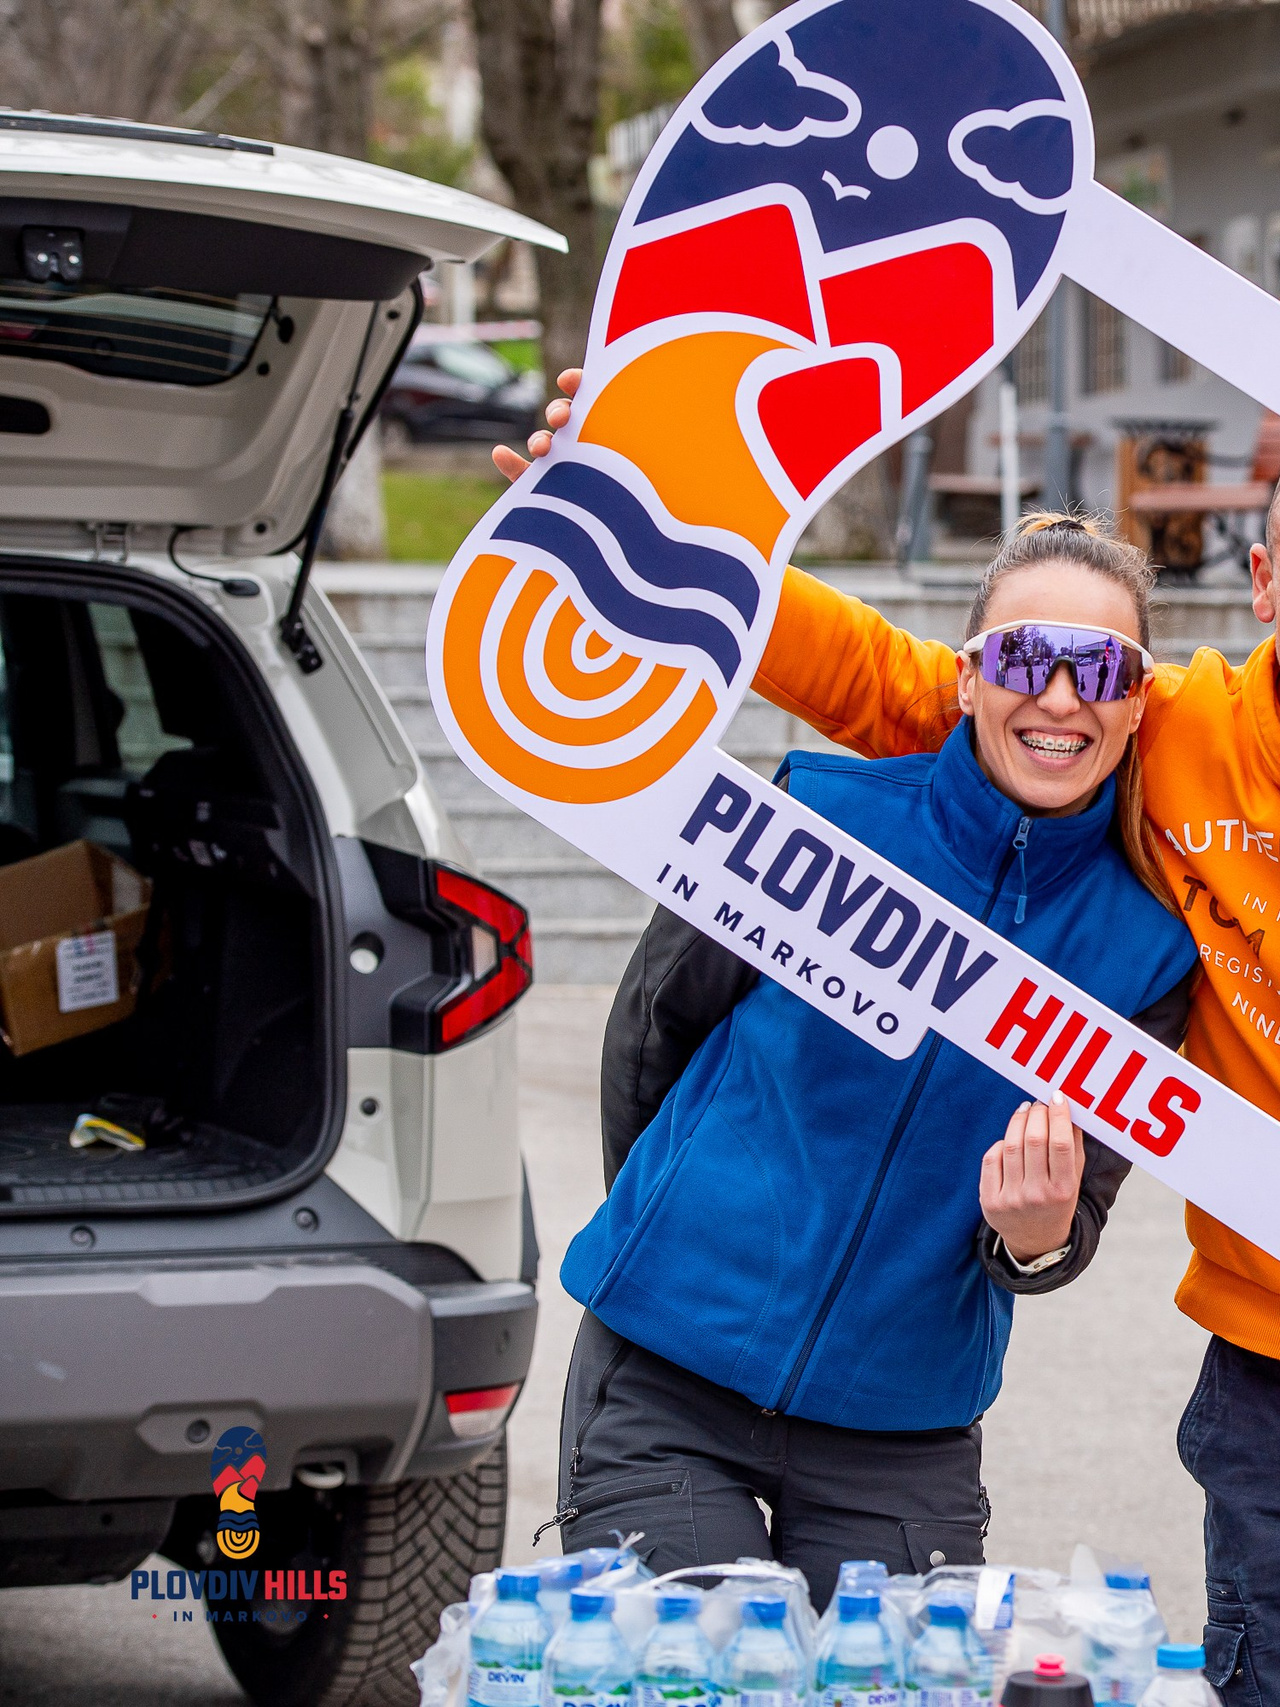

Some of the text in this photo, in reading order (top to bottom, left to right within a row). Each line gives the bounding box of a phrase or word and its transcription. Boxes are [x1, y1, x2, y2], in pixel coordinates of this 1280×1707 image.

[1243, 892, 1268, 914] IN
[656, 862, 899, 1035] IN MARKOVO
[679, 772, 1202, 1157] PLOVDIV HILLS
[1200, 943, 1272, 988] REGIS
[487, 1671, 526, 1683] DEVIN
